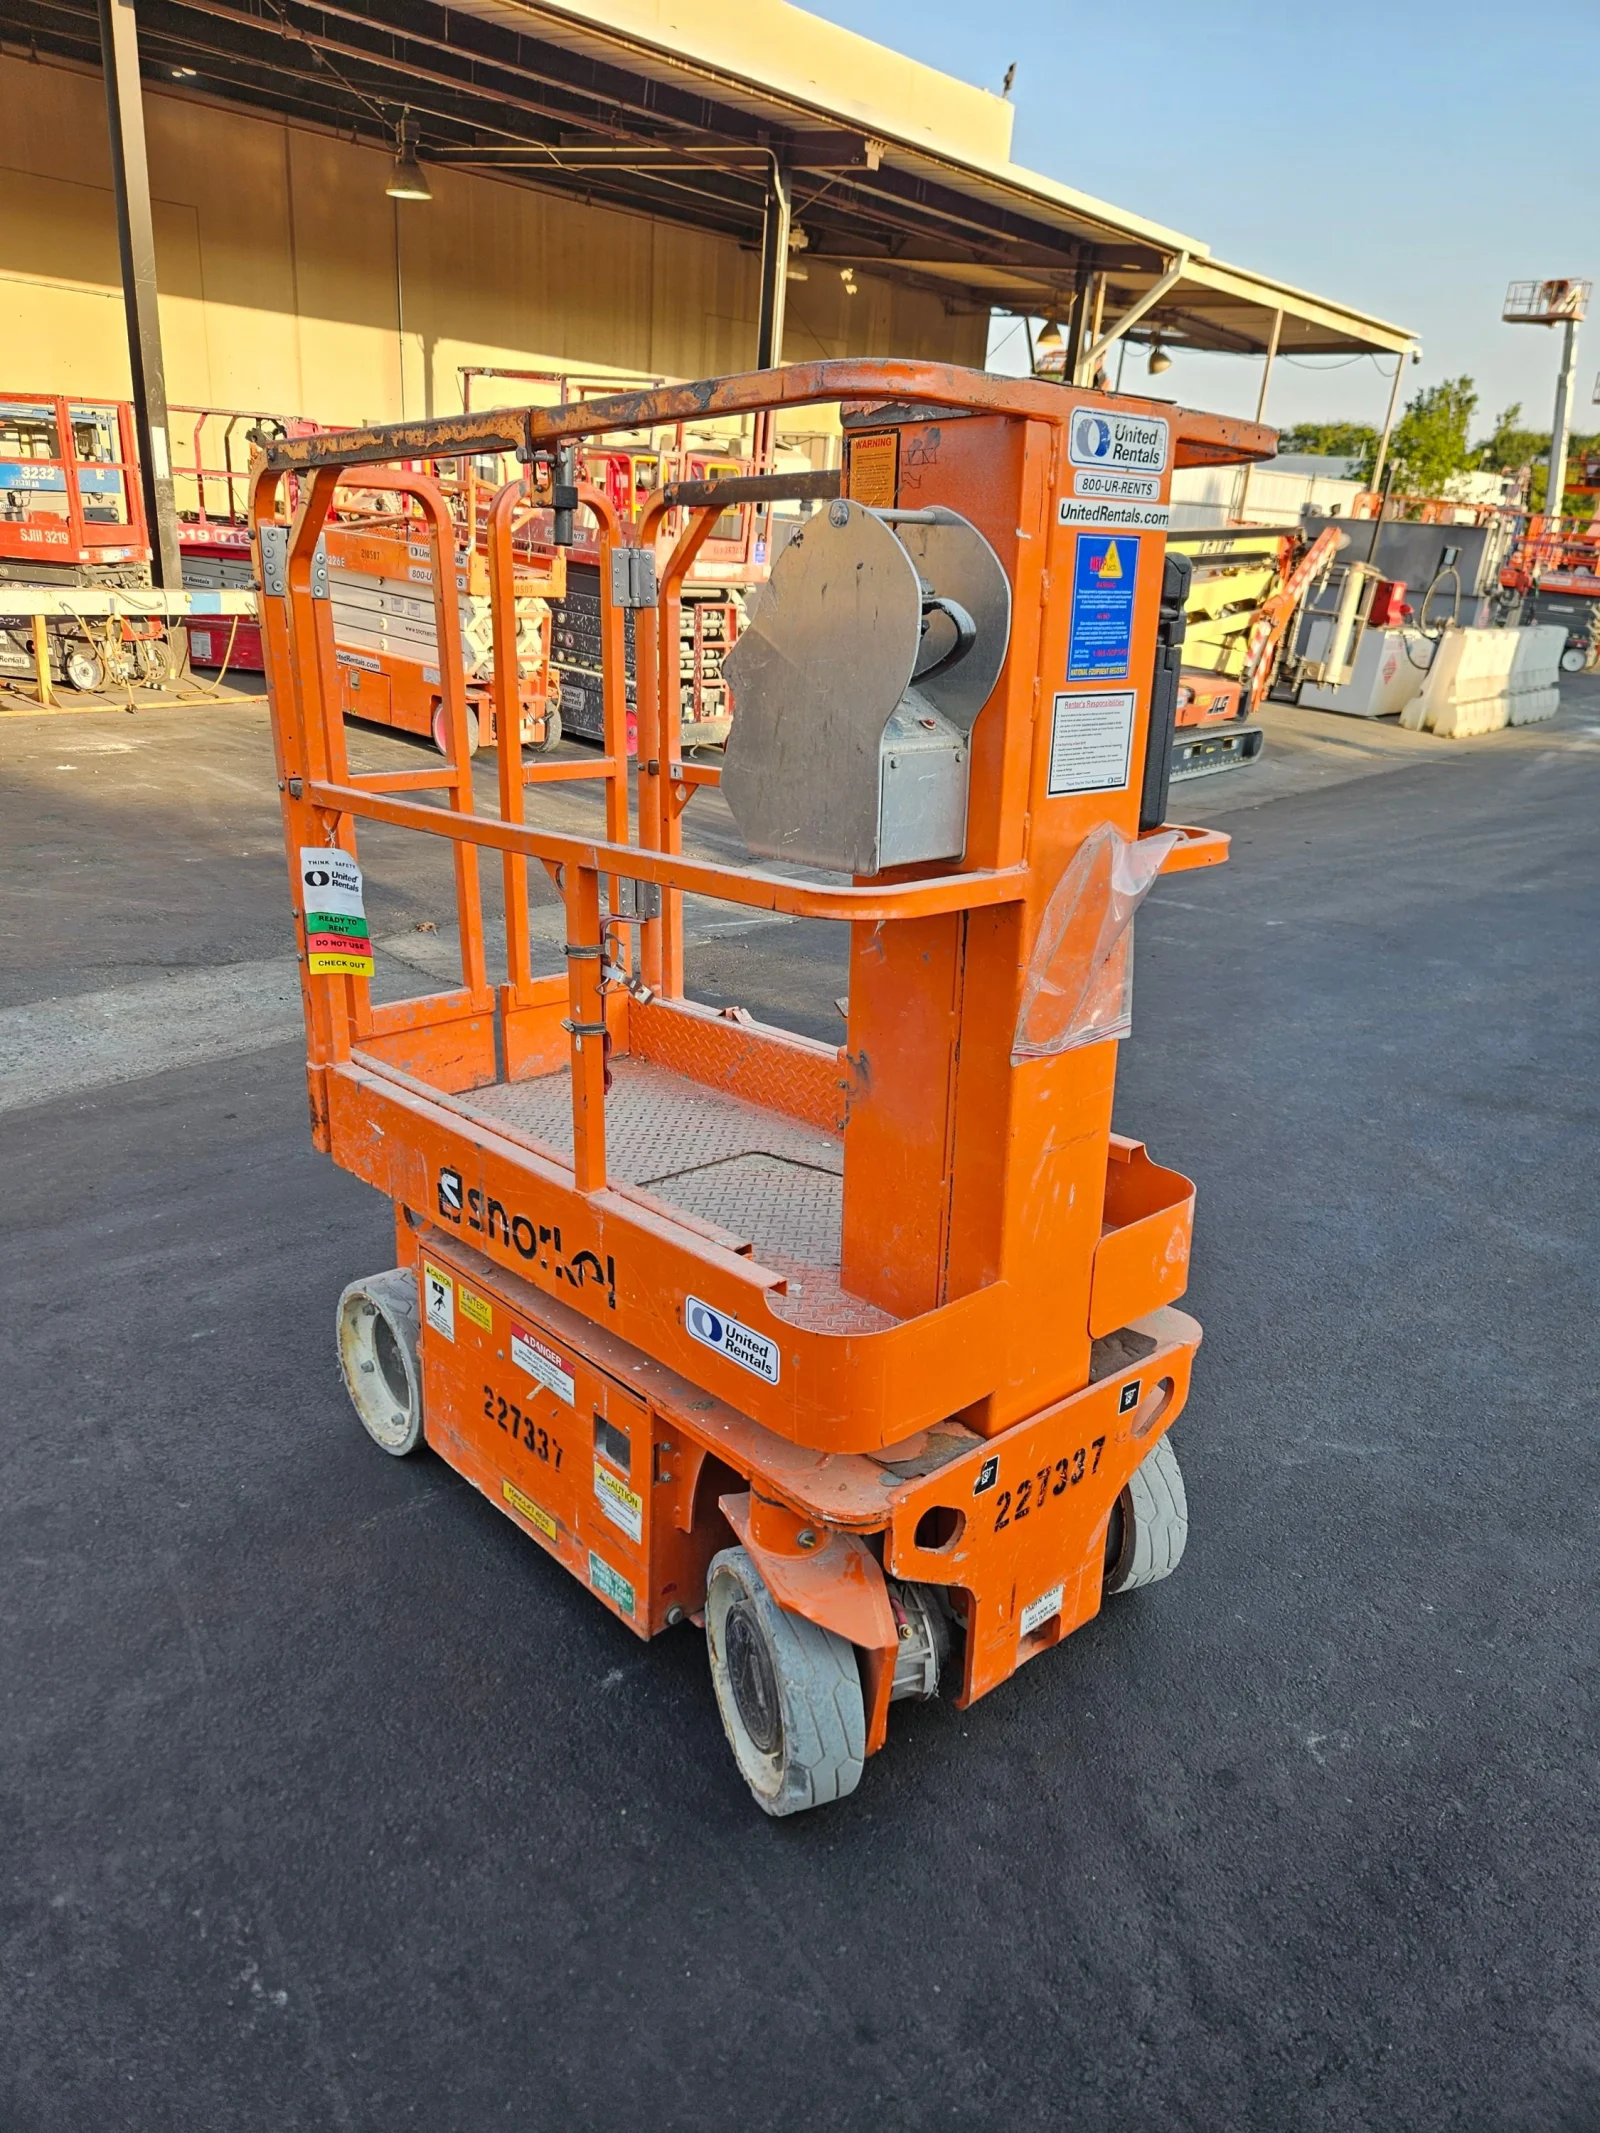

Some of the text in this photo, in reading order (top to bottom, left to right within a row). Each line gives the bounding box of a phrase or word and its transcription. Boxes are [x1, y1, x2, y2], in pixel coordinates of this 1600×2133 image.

[855, 437, 892, 449] WARNING
[1114, 423, 1159, 446] United
[1112, 443, 1160, 464] Rentals
[21, 466, 55, 480] 3232
[1082, 477, 1153, 496] 800-UR-RENTS
[1060, 503, 1169, 526] UnitedRentals.com
[45, 530, 69, 544] 3219
[1064, 700, 1085, 709] Renter's
[1207, 695, 1230, 714] JLG
[335, 861, 356, 869] SAFETY
[331, 871, 358, 883] United
[331, 879, 359, 892] Rentals
[318, 915, 357, 926] READY TO
[328, 924, 350, 932] RENT
[349, 942, 364, 950] USE
[430, 1267, 452, 1288] CAUTION
[725, 1324, 769, 1358] United
[529, 1335, 562, 1367] DANGER
[725, 1339, 772, 1375] Rentals
[483, 1385, 563, 1473] 227337
[605, 1475, 638, 1509] CAUTION
[994, 1435, 1106, 1533] 227337
